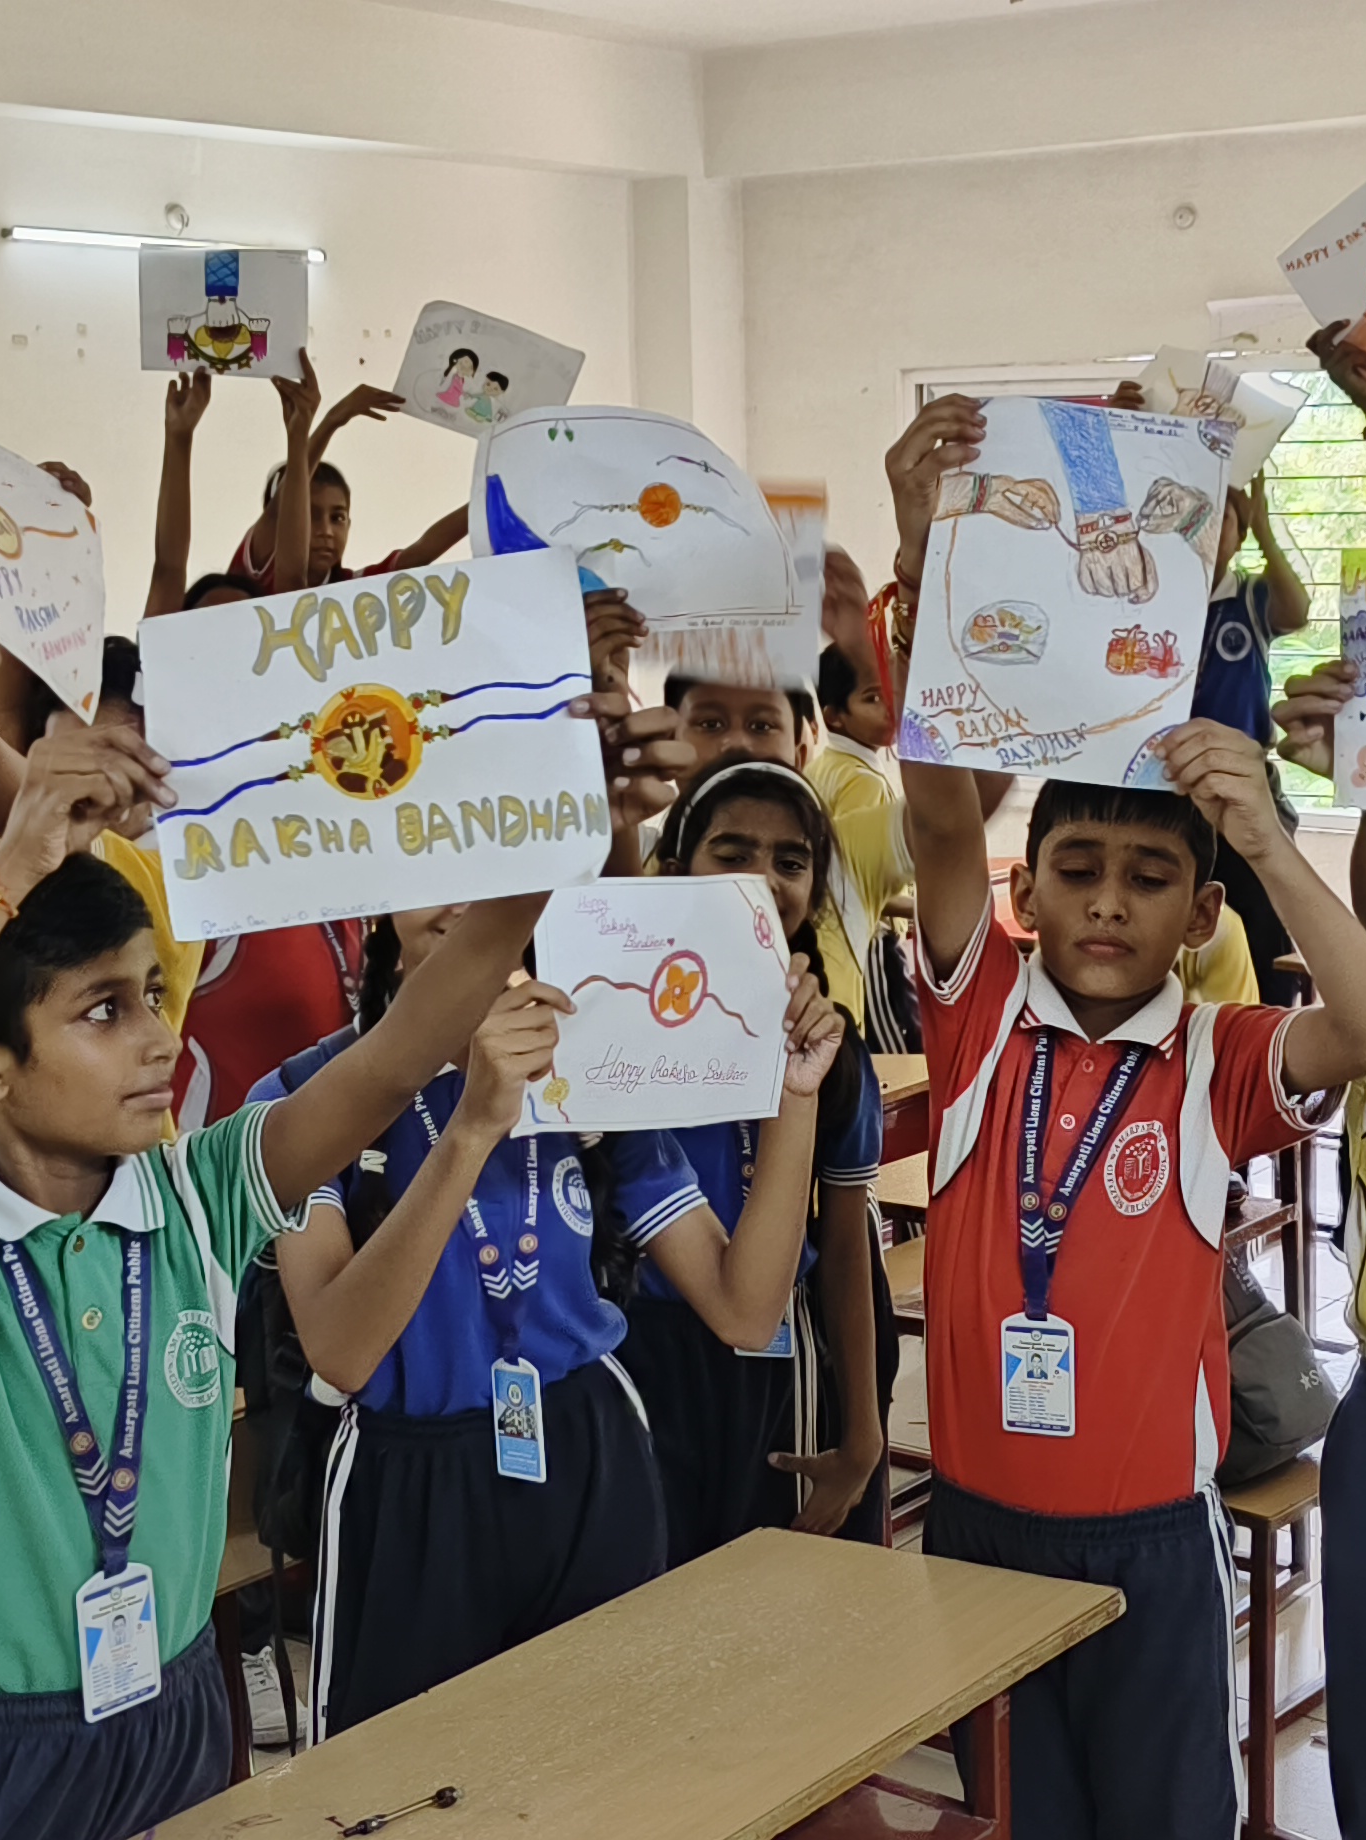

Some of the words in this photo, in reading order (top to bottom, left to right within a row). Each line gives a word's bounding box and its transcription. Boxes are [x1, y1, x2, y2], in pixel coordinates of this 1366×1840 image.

[1285, 245, 1330, 272] HAPPY
[252, 568, 471, 682] HAPPY
[921, 682, 981, 708] HAPPY
[174, 813, 373, 880] RAKHA
[395, 790, 610, 856] BANDHAN
[585, 1043, 647, 1094] Happy
[1029, 1052, 1047, 1097] Citizens
[421, 1111, 441, 1145] tizens
[1026, 1098, 1042, 1128] Lions
[1059, 1143, 1093, 1197] Amarpati
[1083, 1115, 1107, 1146] Lions
[1098, 1072, 1128, 1115] Citizens
[1119, 1044, 1144, 1074] Public
[526, 1138, 538, 1168] Lions
[1023, 1128, 1038, 1184] Amarpati
[465, 1196, 488, 1238] Amarp
[524, 1170, 540, 1227] Amarpati
[126, 1240, 142, 1286] Public
[11, 1261, 39, 1318] Citizens
[32, 1317, 55, 1359] Lions
[127, 1287, 142, 1345] Citizens
[43, 1355, 79, 1424] Amarpati
[126, 1346, 141, 1387] Lions
[119, 1386, 139, 1460] Amarpati
